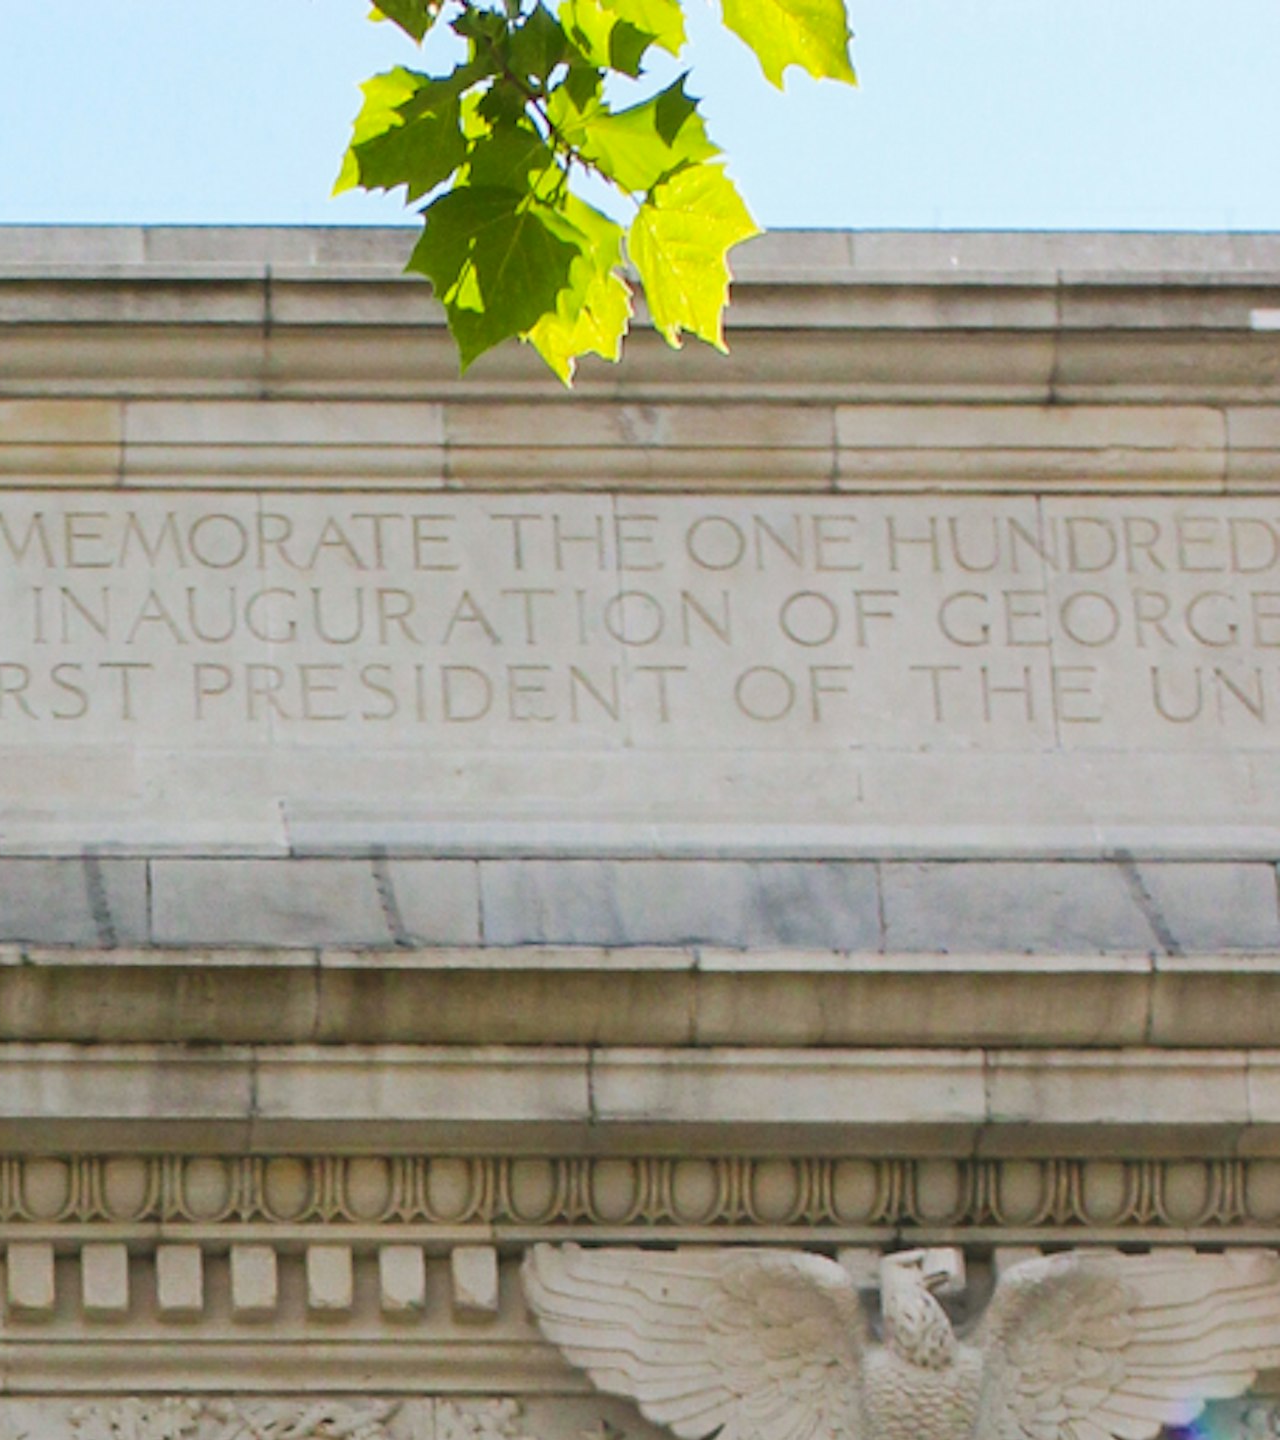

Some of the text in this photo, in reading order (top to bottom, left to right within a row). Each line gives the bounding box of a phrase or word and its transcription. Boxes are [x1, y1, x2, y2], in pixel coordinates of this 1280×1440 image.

[490, 514, 664, 572] THE
[686, 515, 863, 572] ONE
[885, 515, 1280, 574] HUNDRED
[32, 586, 732, 647] INAUGURATION
[780, 590, 900, 648] OF
[194, 663, 688, 724] PRESIDENT
[734, 666, 854, 724] OF
[909, 666, 1102, 724] THE
[1150, 666, 1280, 724] UN
